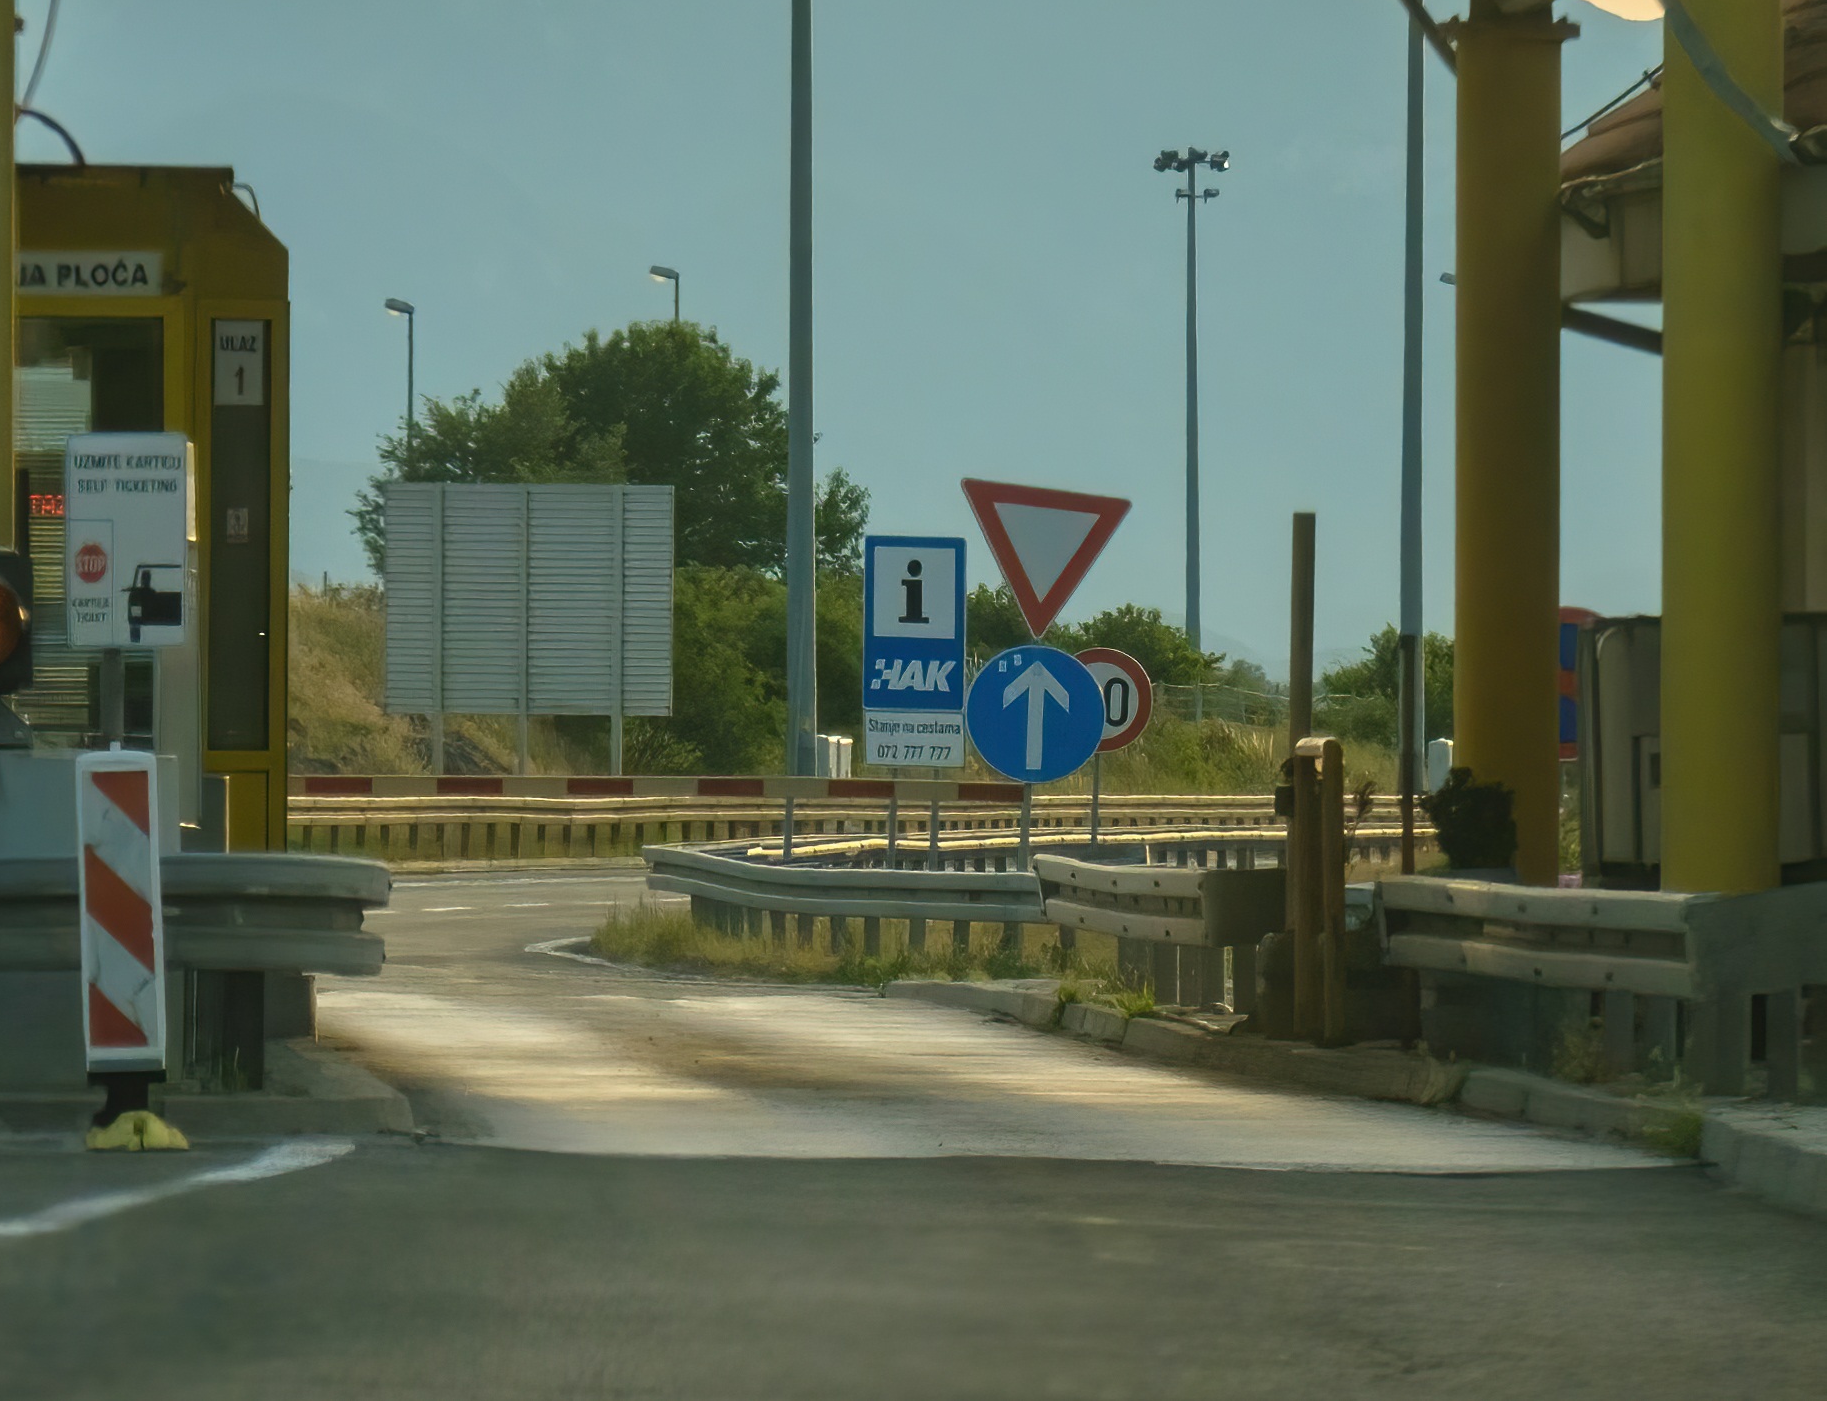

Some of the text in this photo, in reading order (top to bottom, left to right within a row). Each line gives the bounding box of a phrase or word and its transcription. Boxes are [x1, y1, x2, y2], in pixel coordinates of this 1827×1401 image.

[234, 366, 244, 395] 1
[77, 555, 107, 573] STOP
[870, 658, 957, 693] HAK
[868, 718, 961, 736] Stanje na cestama
[877, 744, 951, 760] 072 777 777
